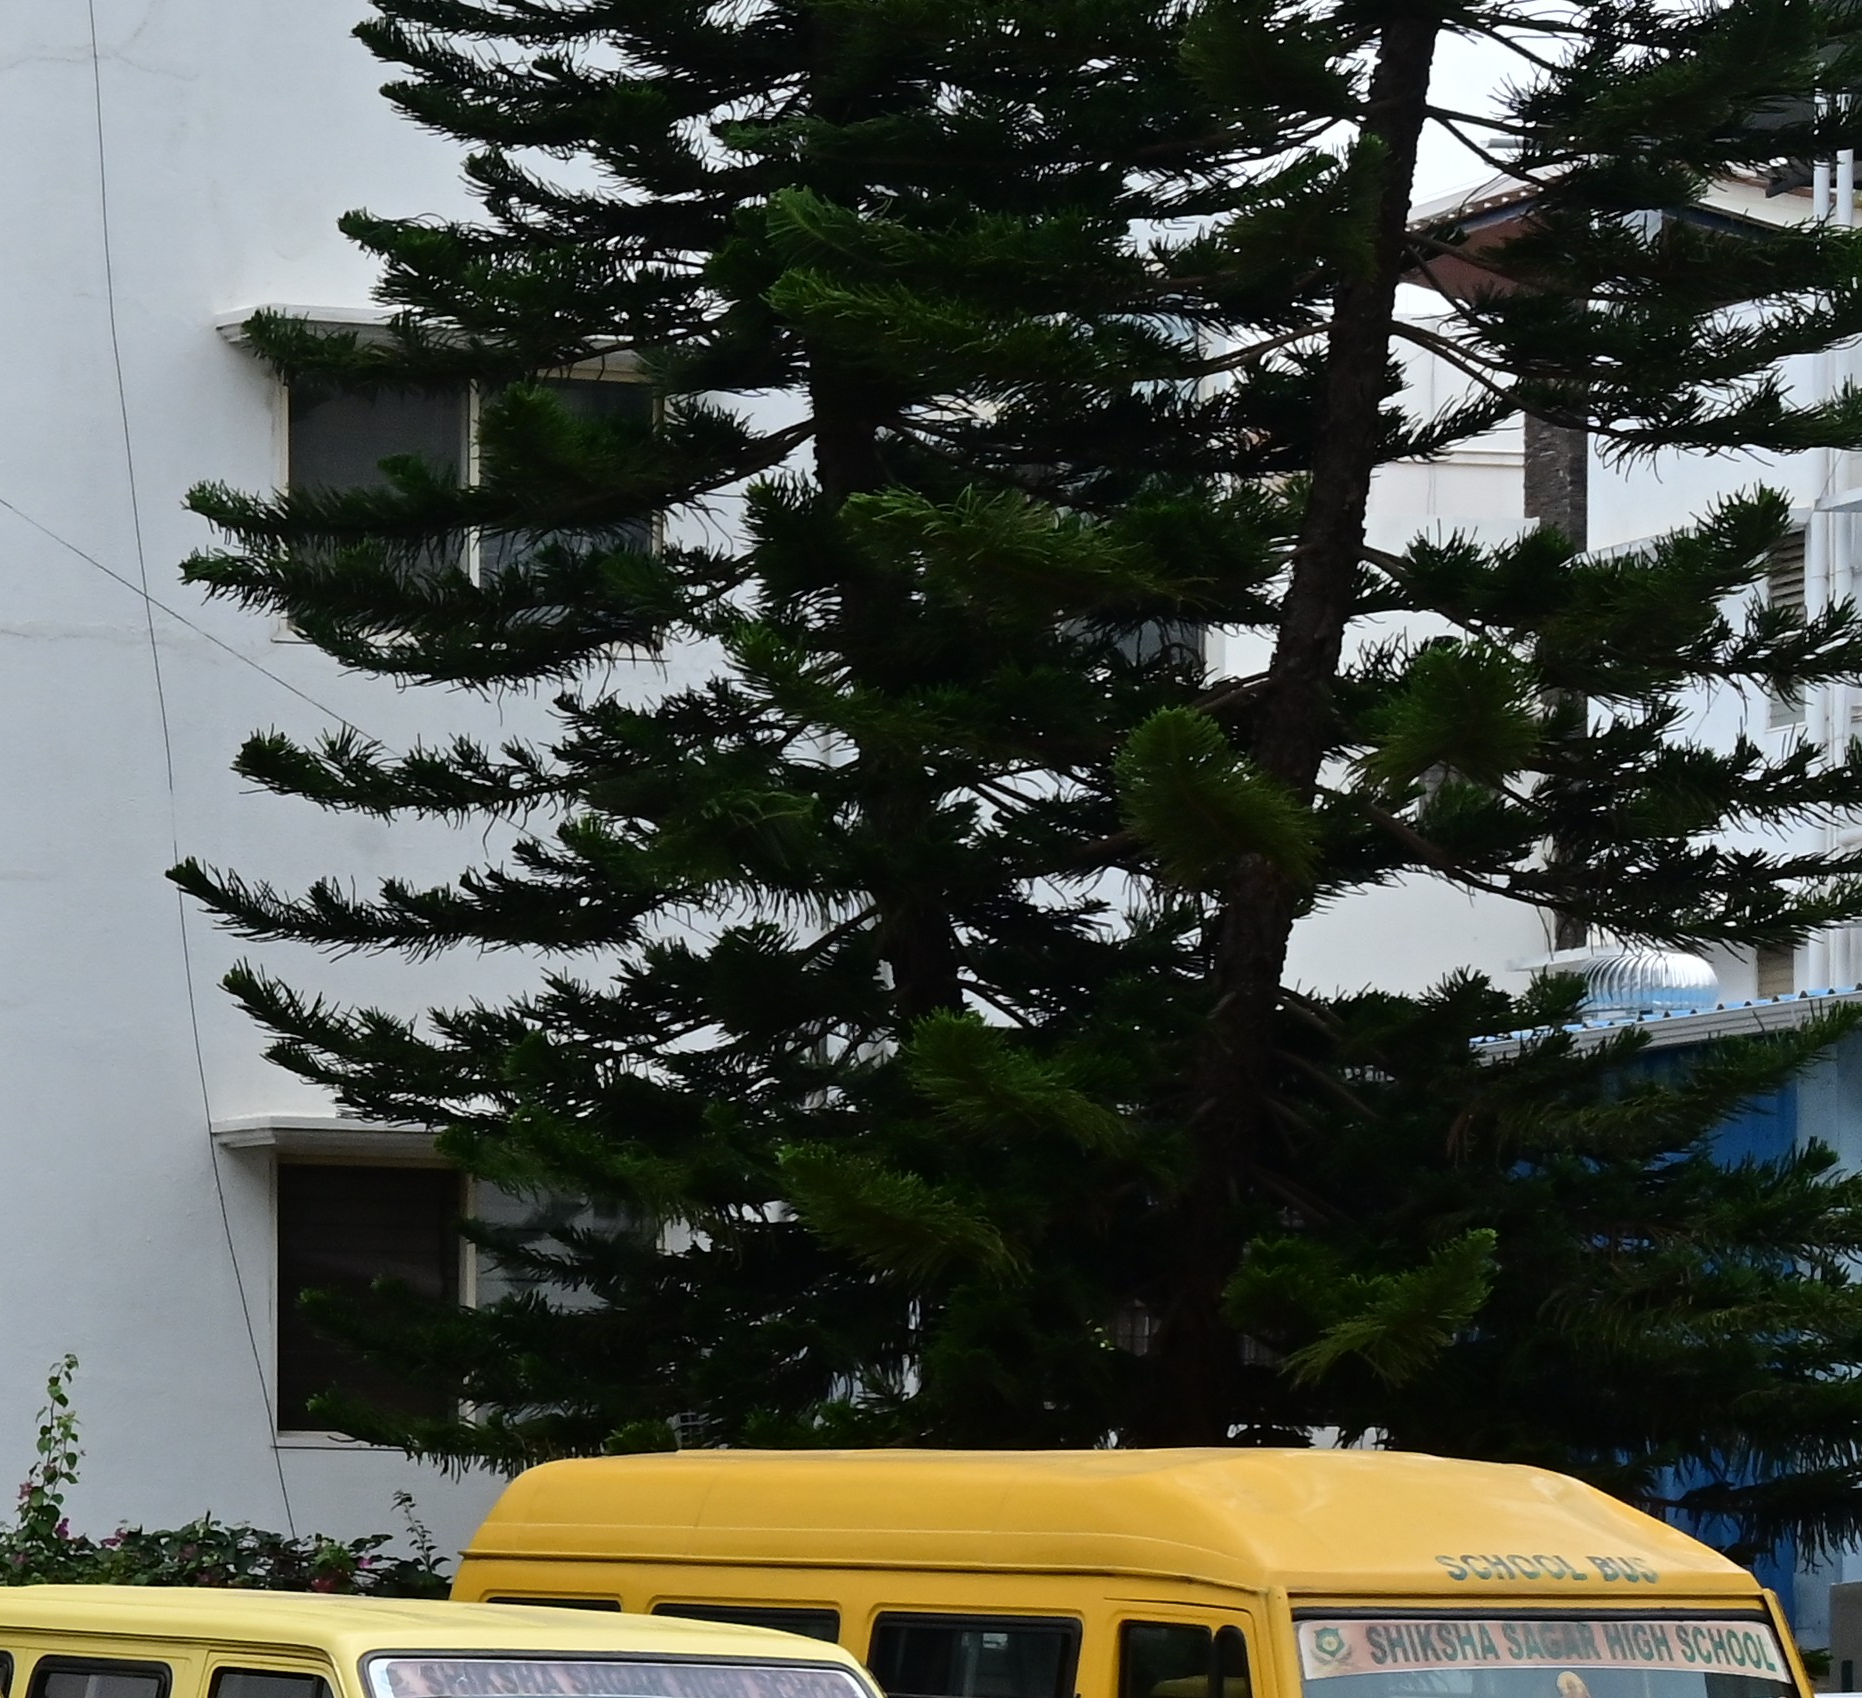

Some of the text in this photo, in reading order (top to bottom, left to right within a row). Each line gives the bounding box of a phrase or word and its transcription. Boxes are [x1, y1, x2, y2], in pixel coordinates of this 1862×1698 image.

[1435, 1554, 1661, 1583] SCHOOL BUS
[1365, 1623, 1777, 1672] SHIKSHA SAGAR HIGH SCHOOL
